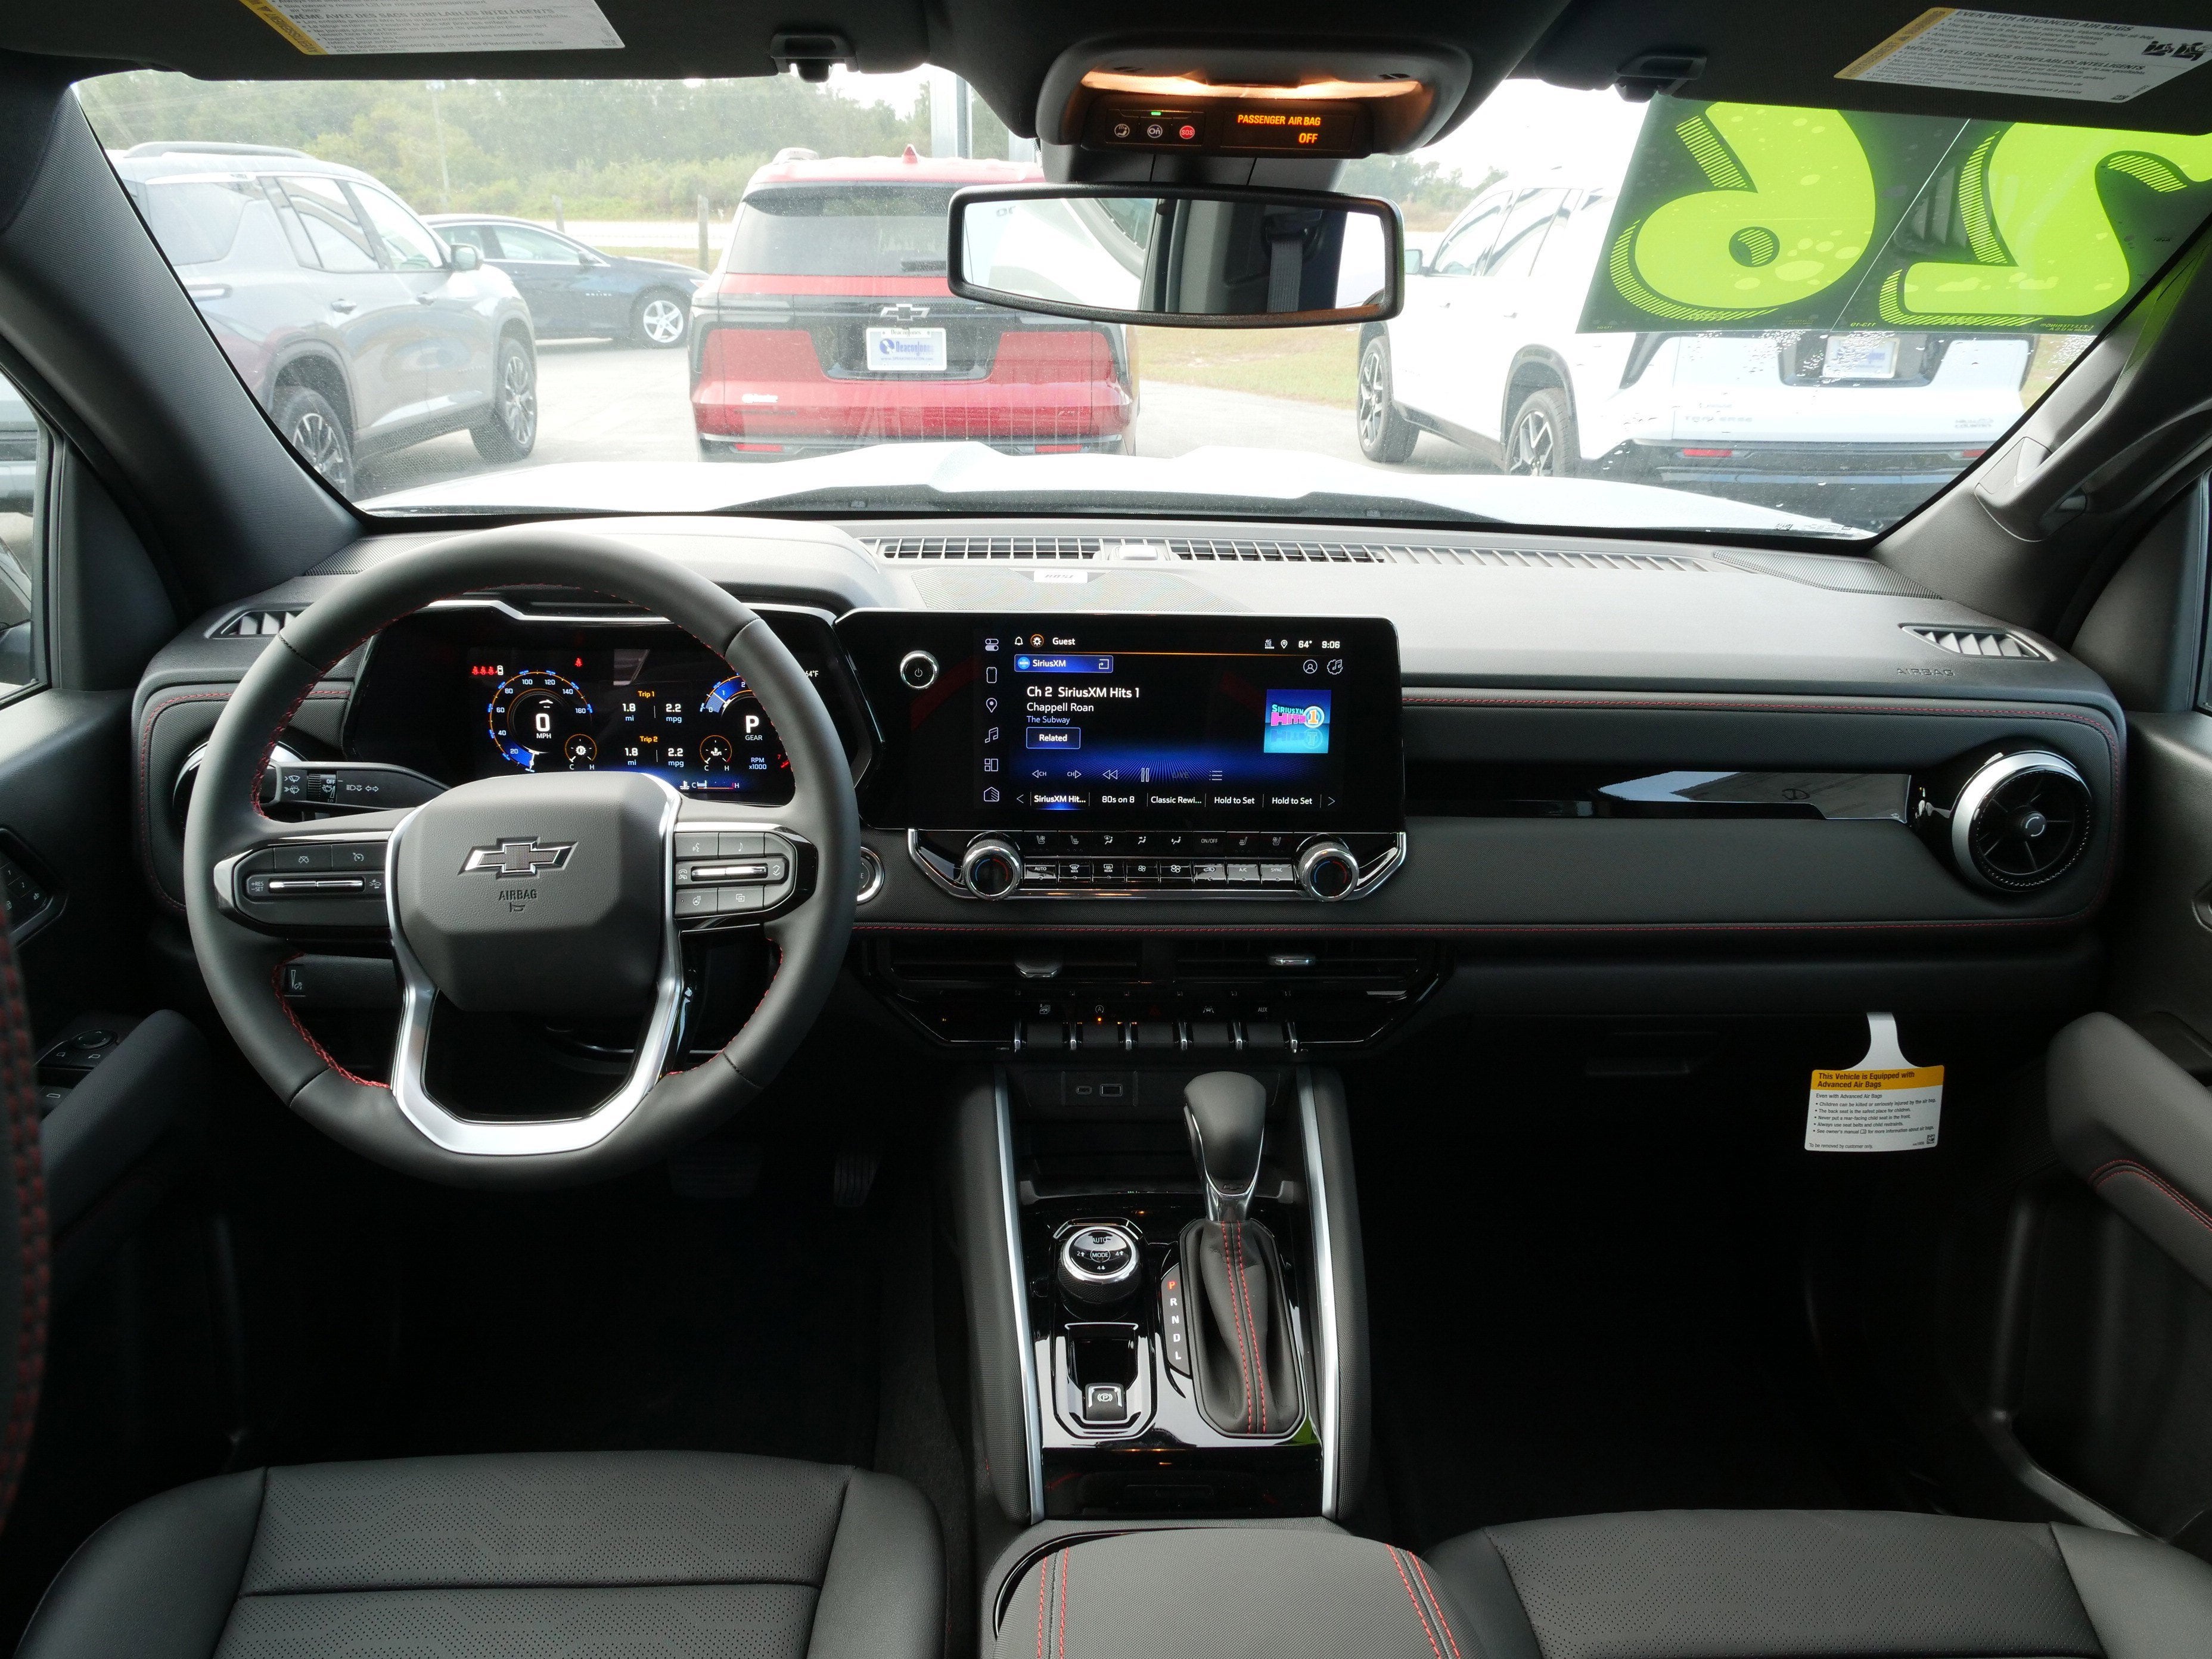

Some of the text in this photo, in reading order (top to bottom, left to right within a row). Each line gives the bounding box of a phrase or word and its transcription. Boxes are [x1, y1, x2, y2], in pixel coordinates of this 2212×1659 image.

[1986, 13, 2017, 21] WITH
[2017, 15, 2079, 27] ADVANCED
[1237, 114, 1321, 126] PASSENGER AIR BAG
[1298, 133, 1318, 144] OFF
[1897, 668, 1954, 676] AIRBAG
[1027, 686, 1139, 698] Ch 2 SiriusXM Hits 1
[622, 703, 636, 712] 1.8
[666, 704, 681, 712] 2.2
[1027, 703, 1094, 713] Chappell Roan
[1042, 716, 1070, 725] Subway
[1308, 709, 1319, 725] 1
[536, 713, 551, 732] 0
[745, 716, 759, 733] P
[625, 748, 638, 756] 1.8
[668, 748, 684, 756] 2.2
[499, 889, 538, 900] AIRBAG
[1869, 1072, 1899, 1080] Equipped
[1170, 1298, 1178, 1306] R
[1173, 1334, 1180, 1342] D
[1175, 1352, 1182, 1360] L
